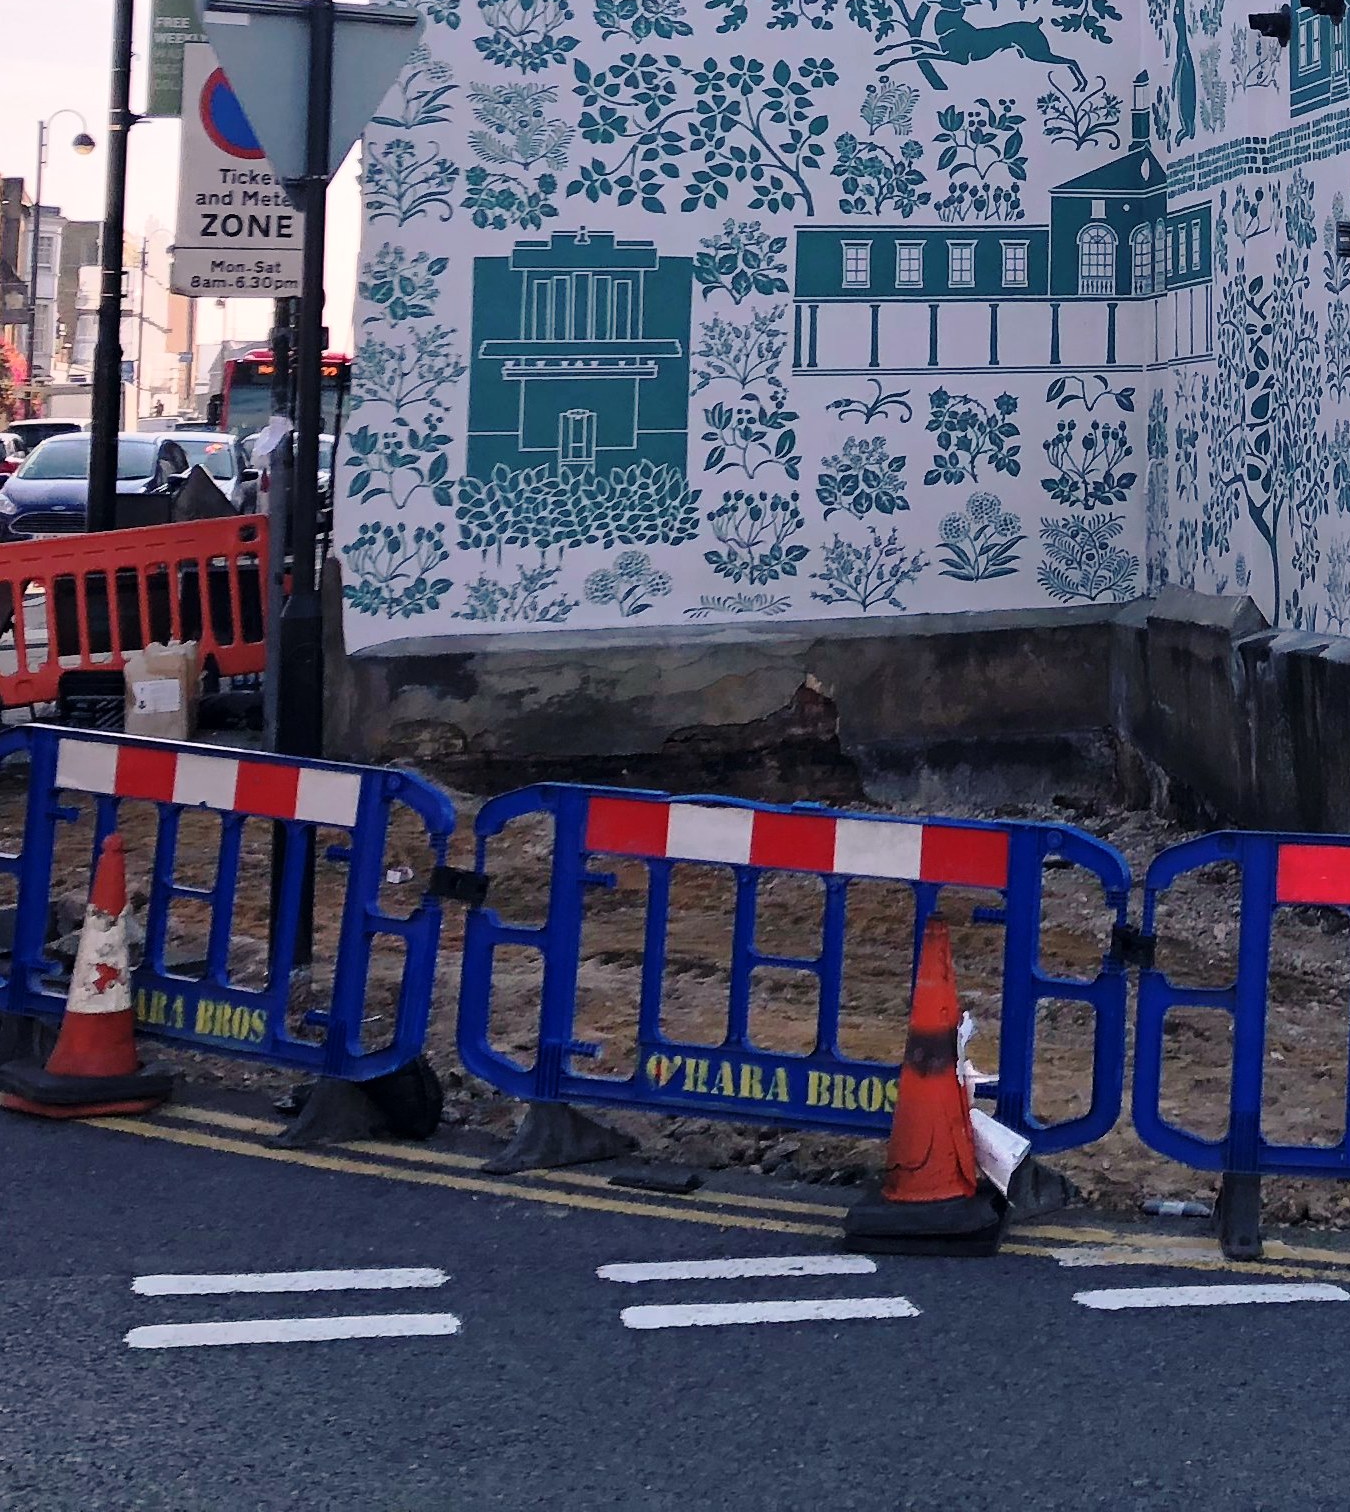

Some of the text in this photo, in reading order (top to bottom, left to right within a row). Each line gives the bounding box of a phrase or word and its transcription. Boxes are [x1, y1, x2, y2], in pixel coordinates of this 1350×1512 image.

[156, 17, 190, 29] FREE
[195, 190, 293, 208] and Mete
[200, 213, 293, 238] ZONE
[210, 260, 282, 274] Mon-Sat
[195, 999, 267, 1042] BROS
[645, 1053, 899, 1113] O'HARA BROS
